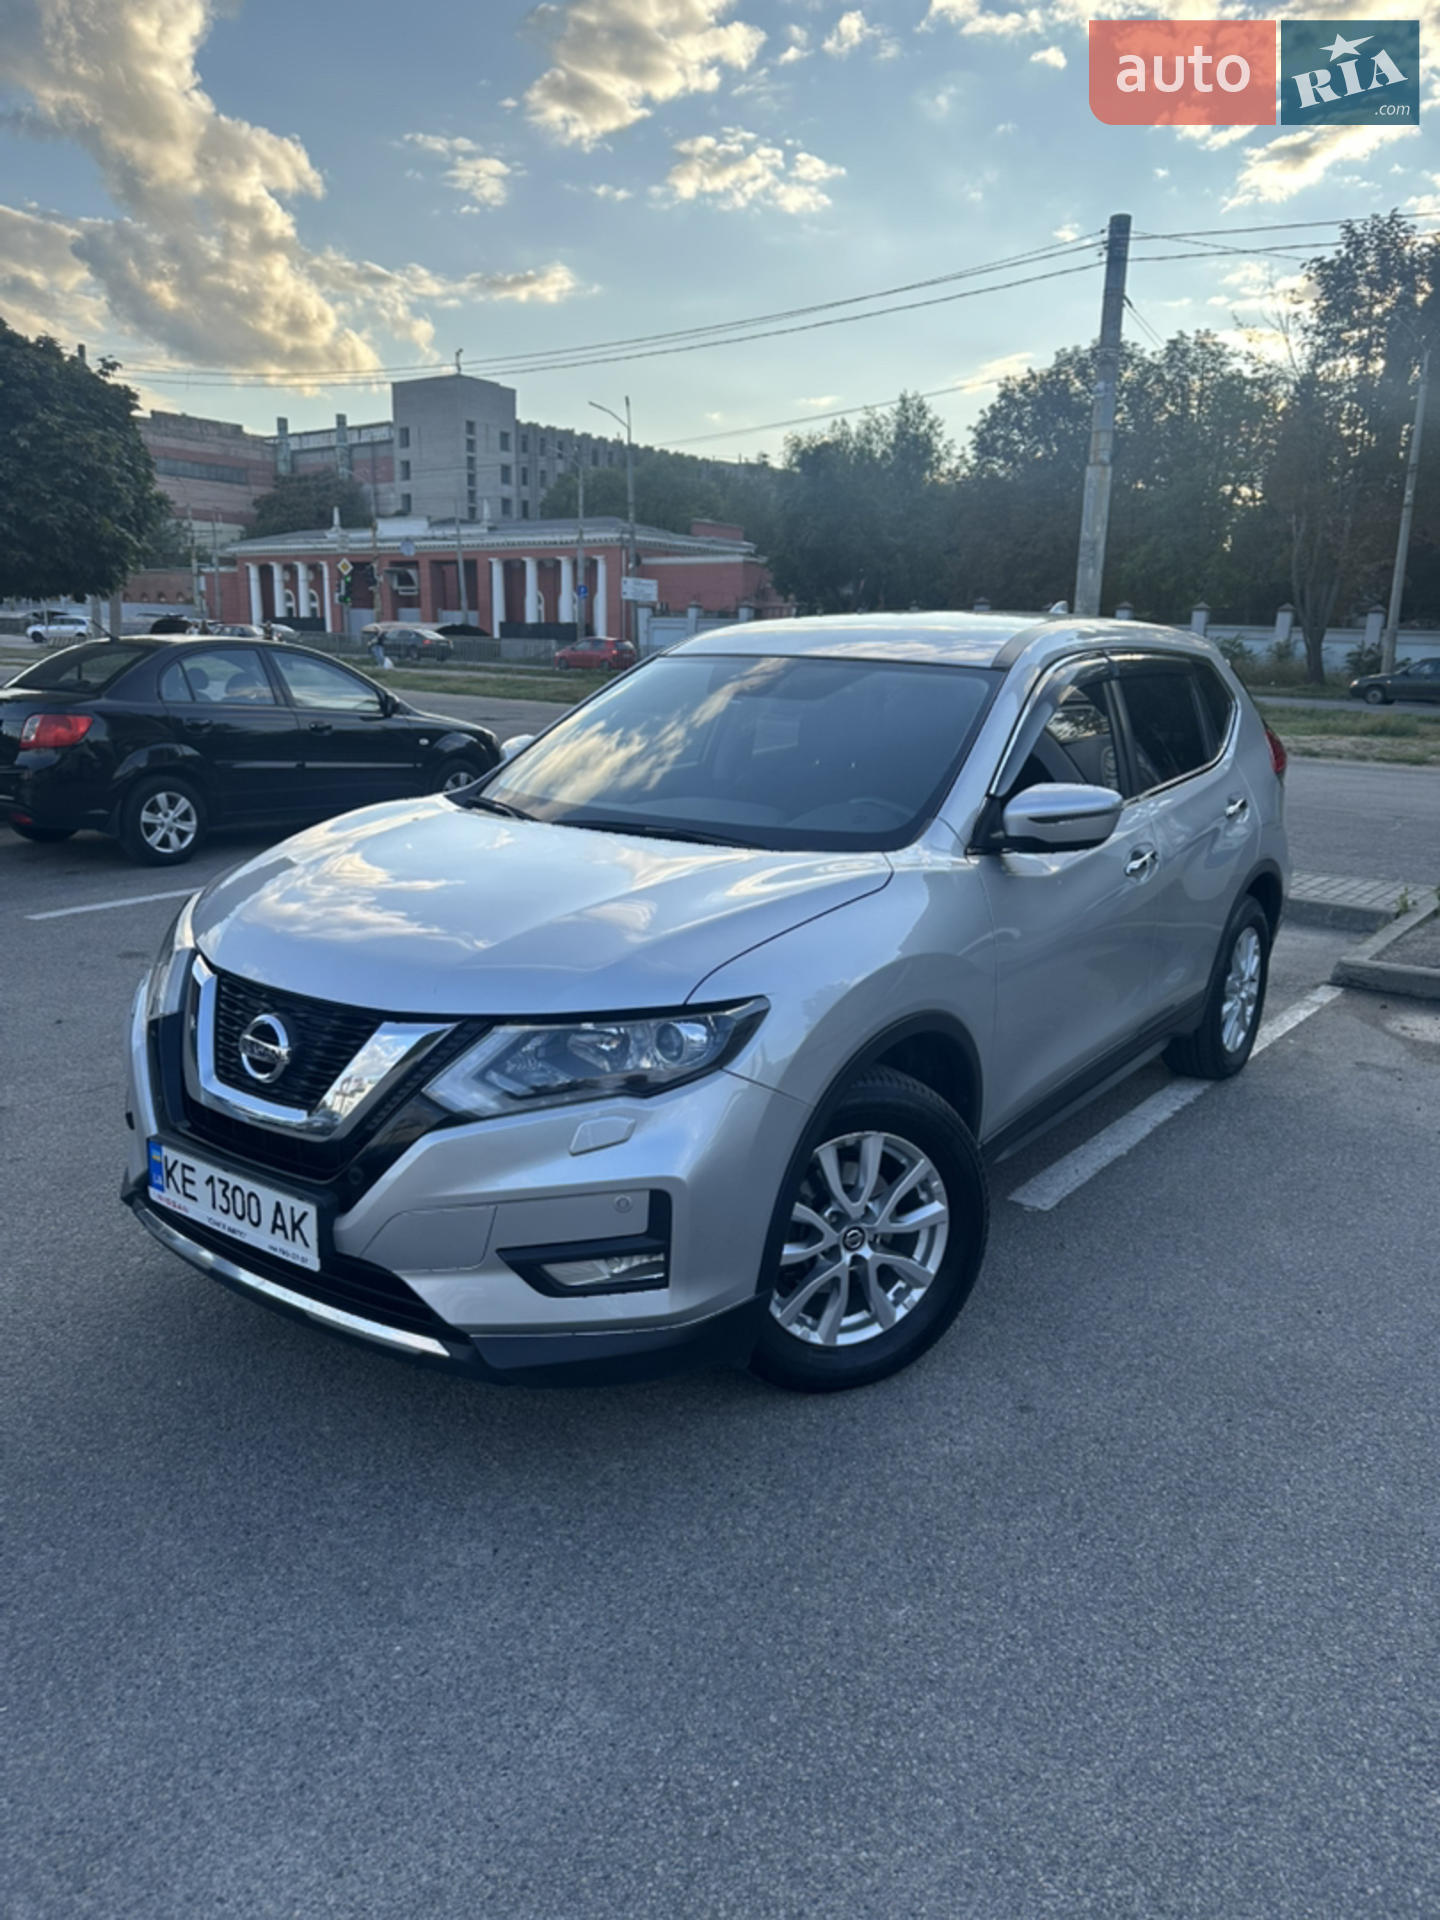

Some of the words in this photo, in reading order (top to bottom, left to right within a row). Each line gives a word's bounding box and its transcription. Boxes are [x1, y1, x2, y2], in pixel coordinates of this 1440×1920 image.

[164, 1155, 199, 1203] KE
[205, 1175, 262, 1228] 1300
[271, 1200, 311, 1249] AK
